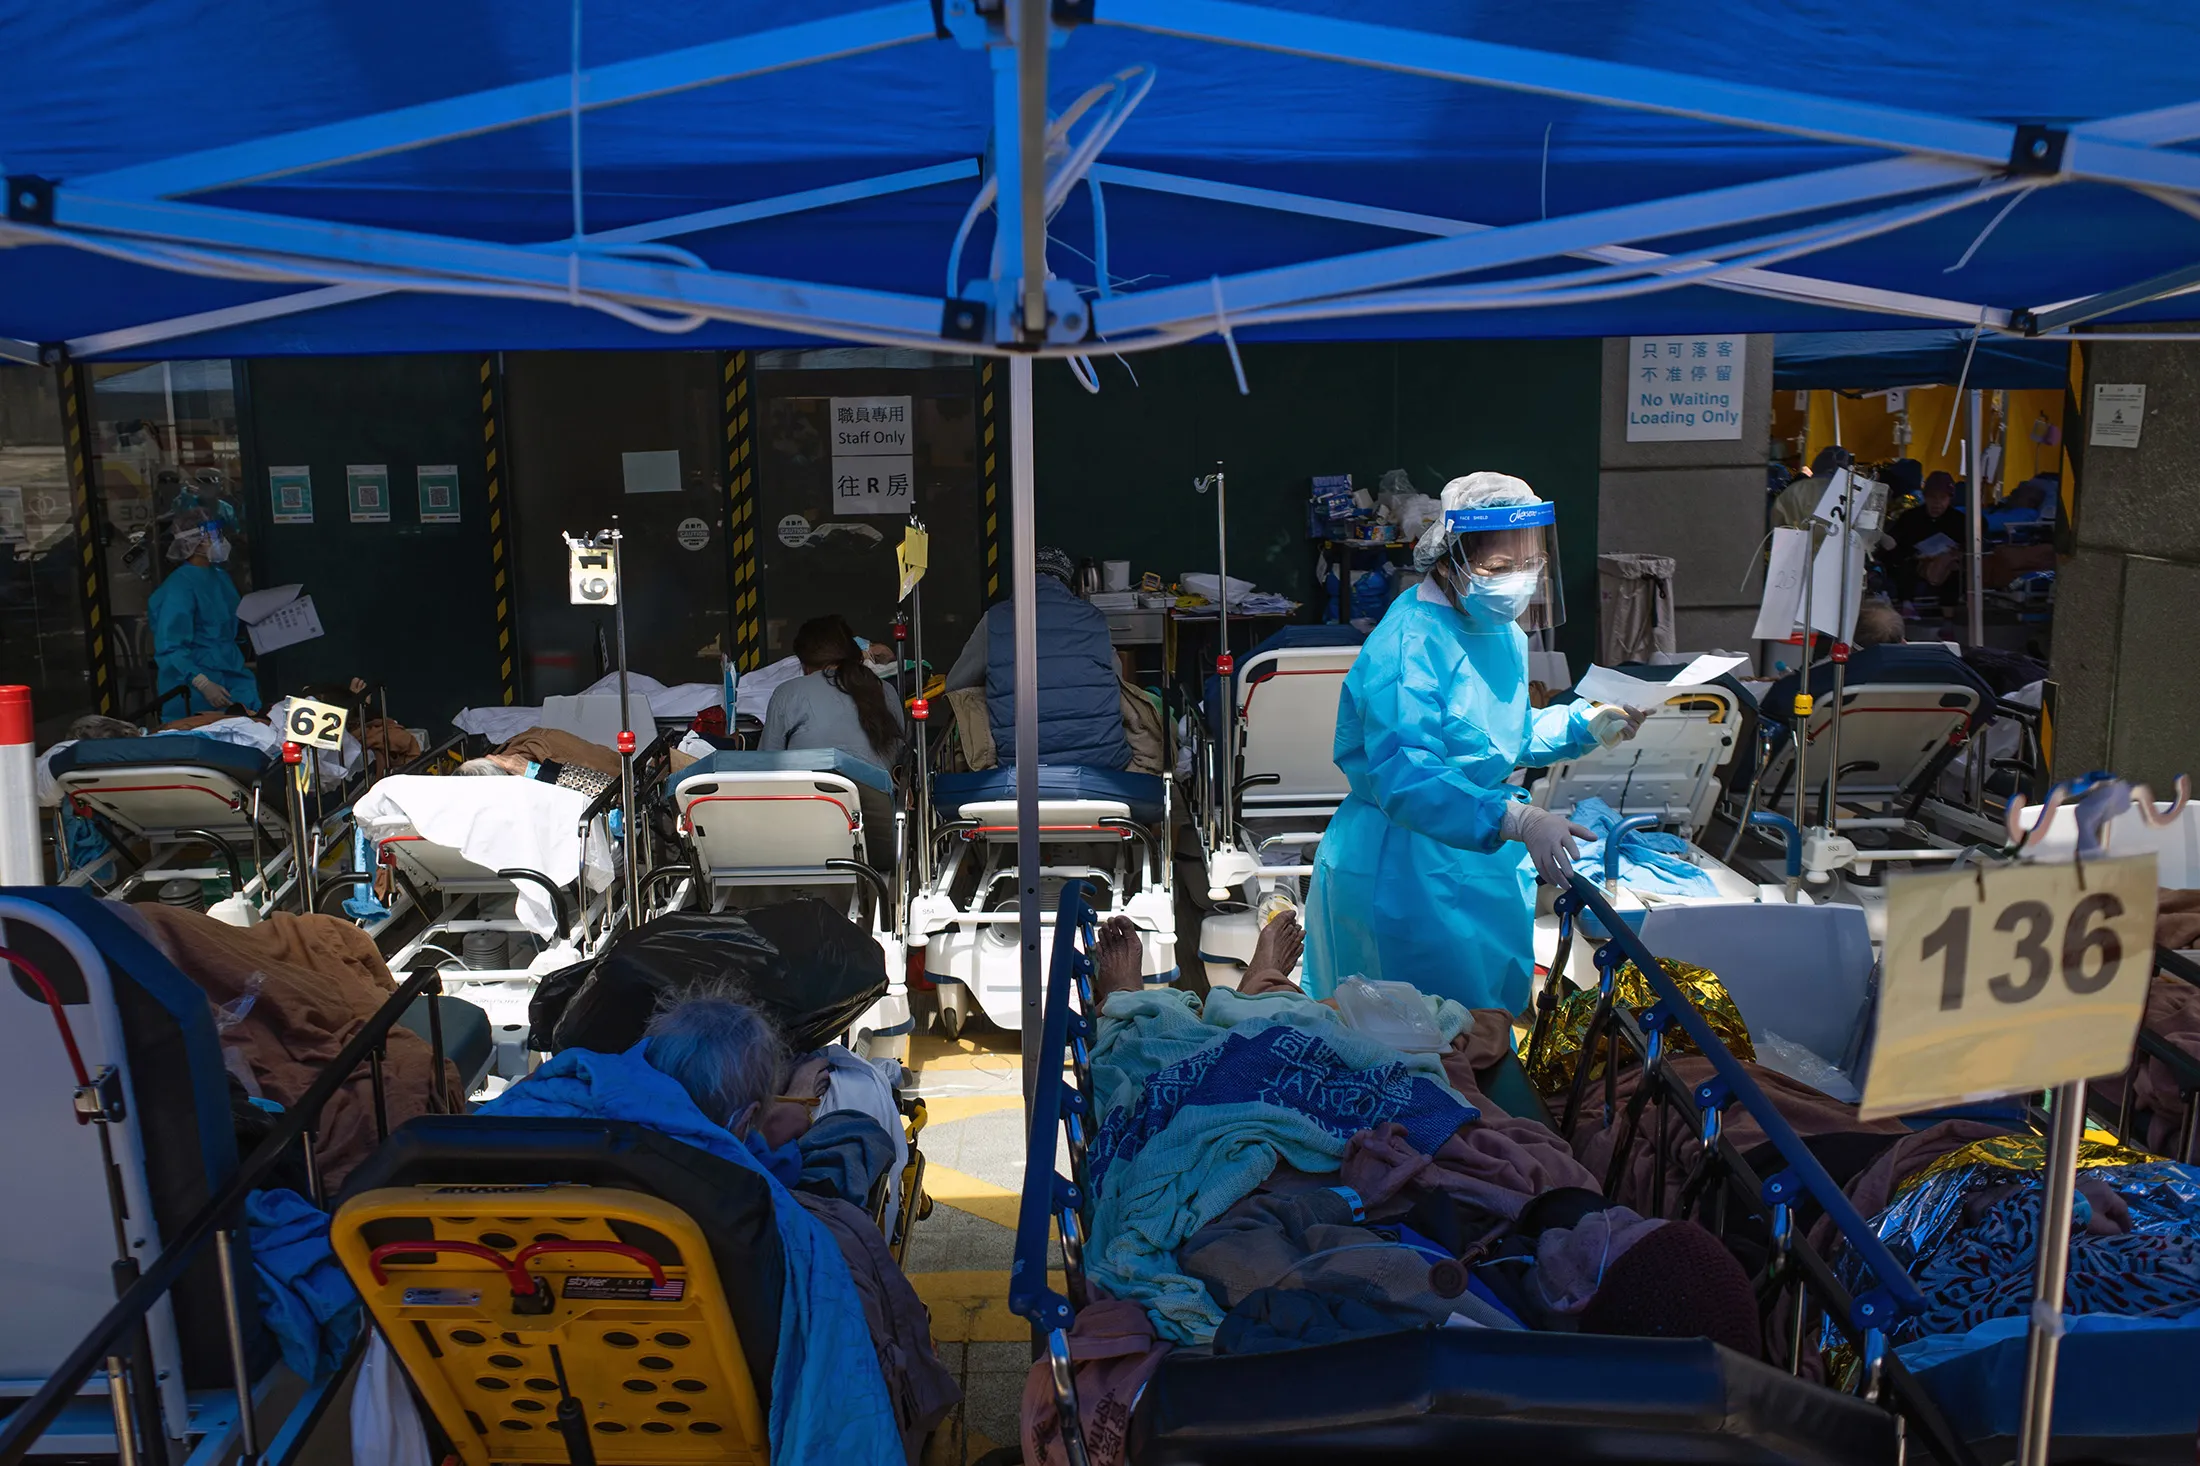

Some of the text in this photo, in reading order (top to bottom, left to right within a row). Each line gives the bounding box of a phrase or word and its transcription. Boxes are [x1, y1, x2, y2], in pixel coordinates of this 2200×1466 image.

[1641, 341, 1733, 359] 只可落客
[1640, 365, 1732, 383] 不准停留
[1640, 392, 1730, 408] No Waiting
[837, 405, 904, 424] 職員專用
[1630, 409, 1740, 427] Loading Only
[838, 430, 906, 446] Staff Only
[837, 473, 909, 498] 往 R 房
[578, 551, 609, 601] 61
[290, 706, 342, 743] 62
[1920, 892, 2125, 1012] 136
[566, 1276, 611, 1288] stryker
